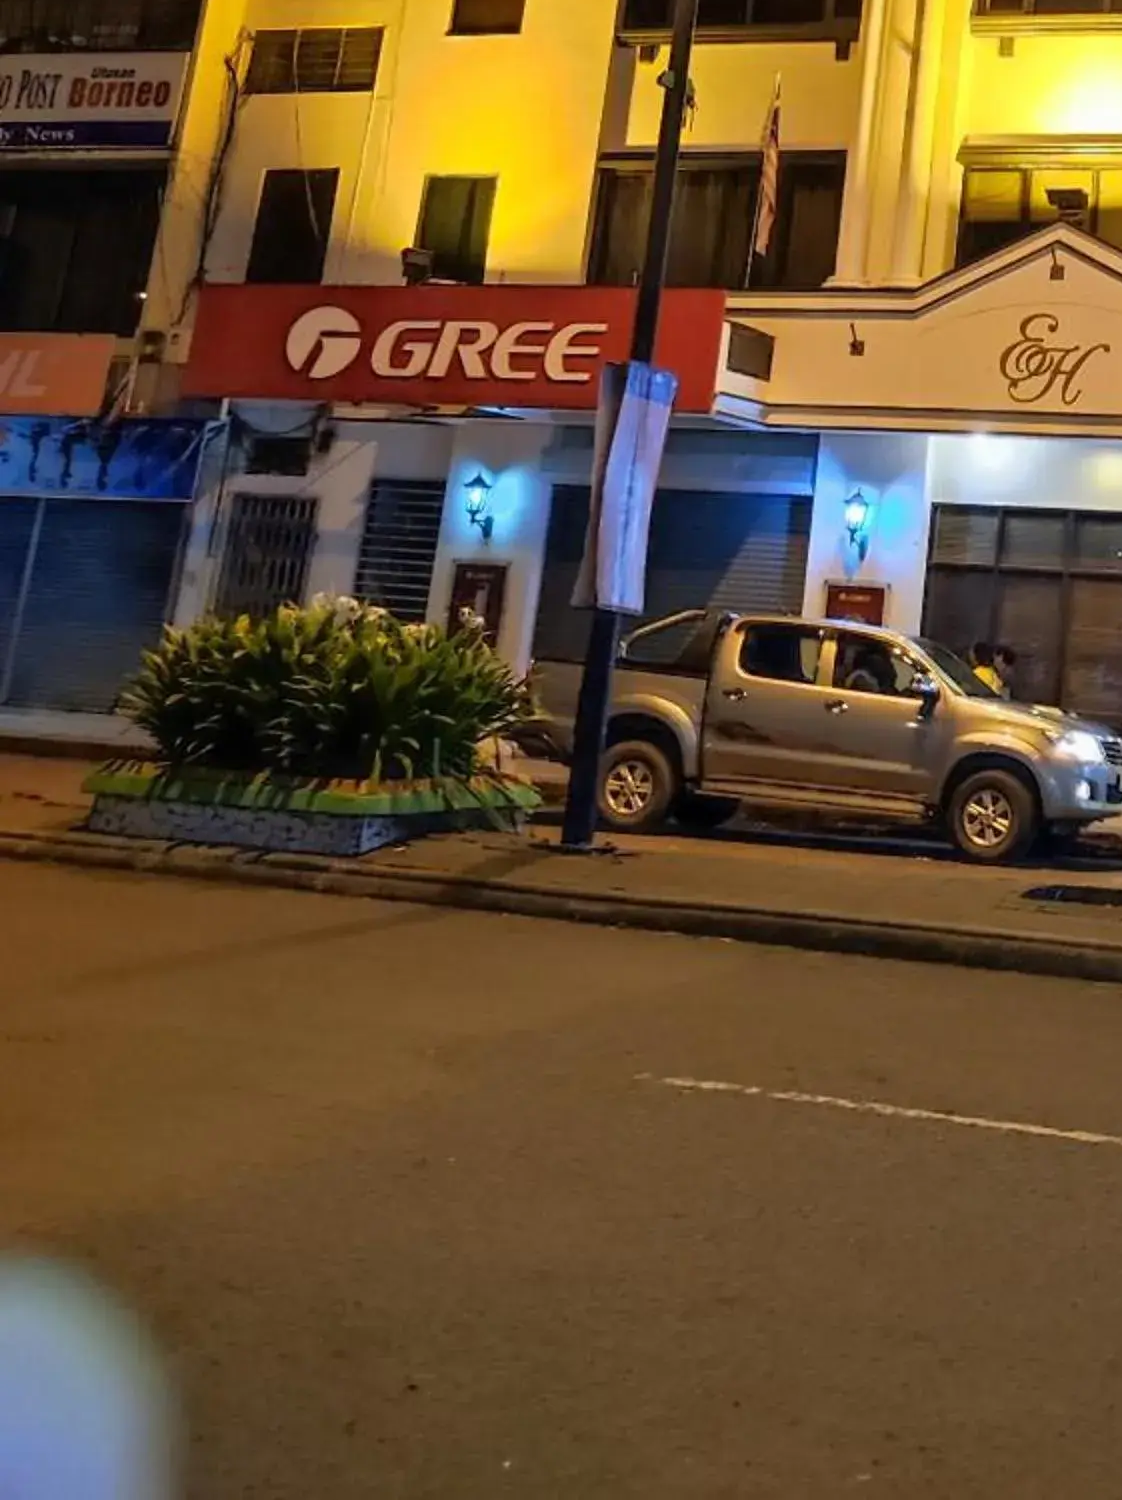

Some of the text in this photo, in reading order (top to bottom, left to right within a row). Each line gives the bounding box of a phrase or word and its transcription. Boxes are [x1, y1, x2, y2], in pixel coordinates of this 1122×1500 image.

[67, 76, 171, 109] Borneo
[26, 126, 75, 142] News
[371, 320, 608, 381] GREE
